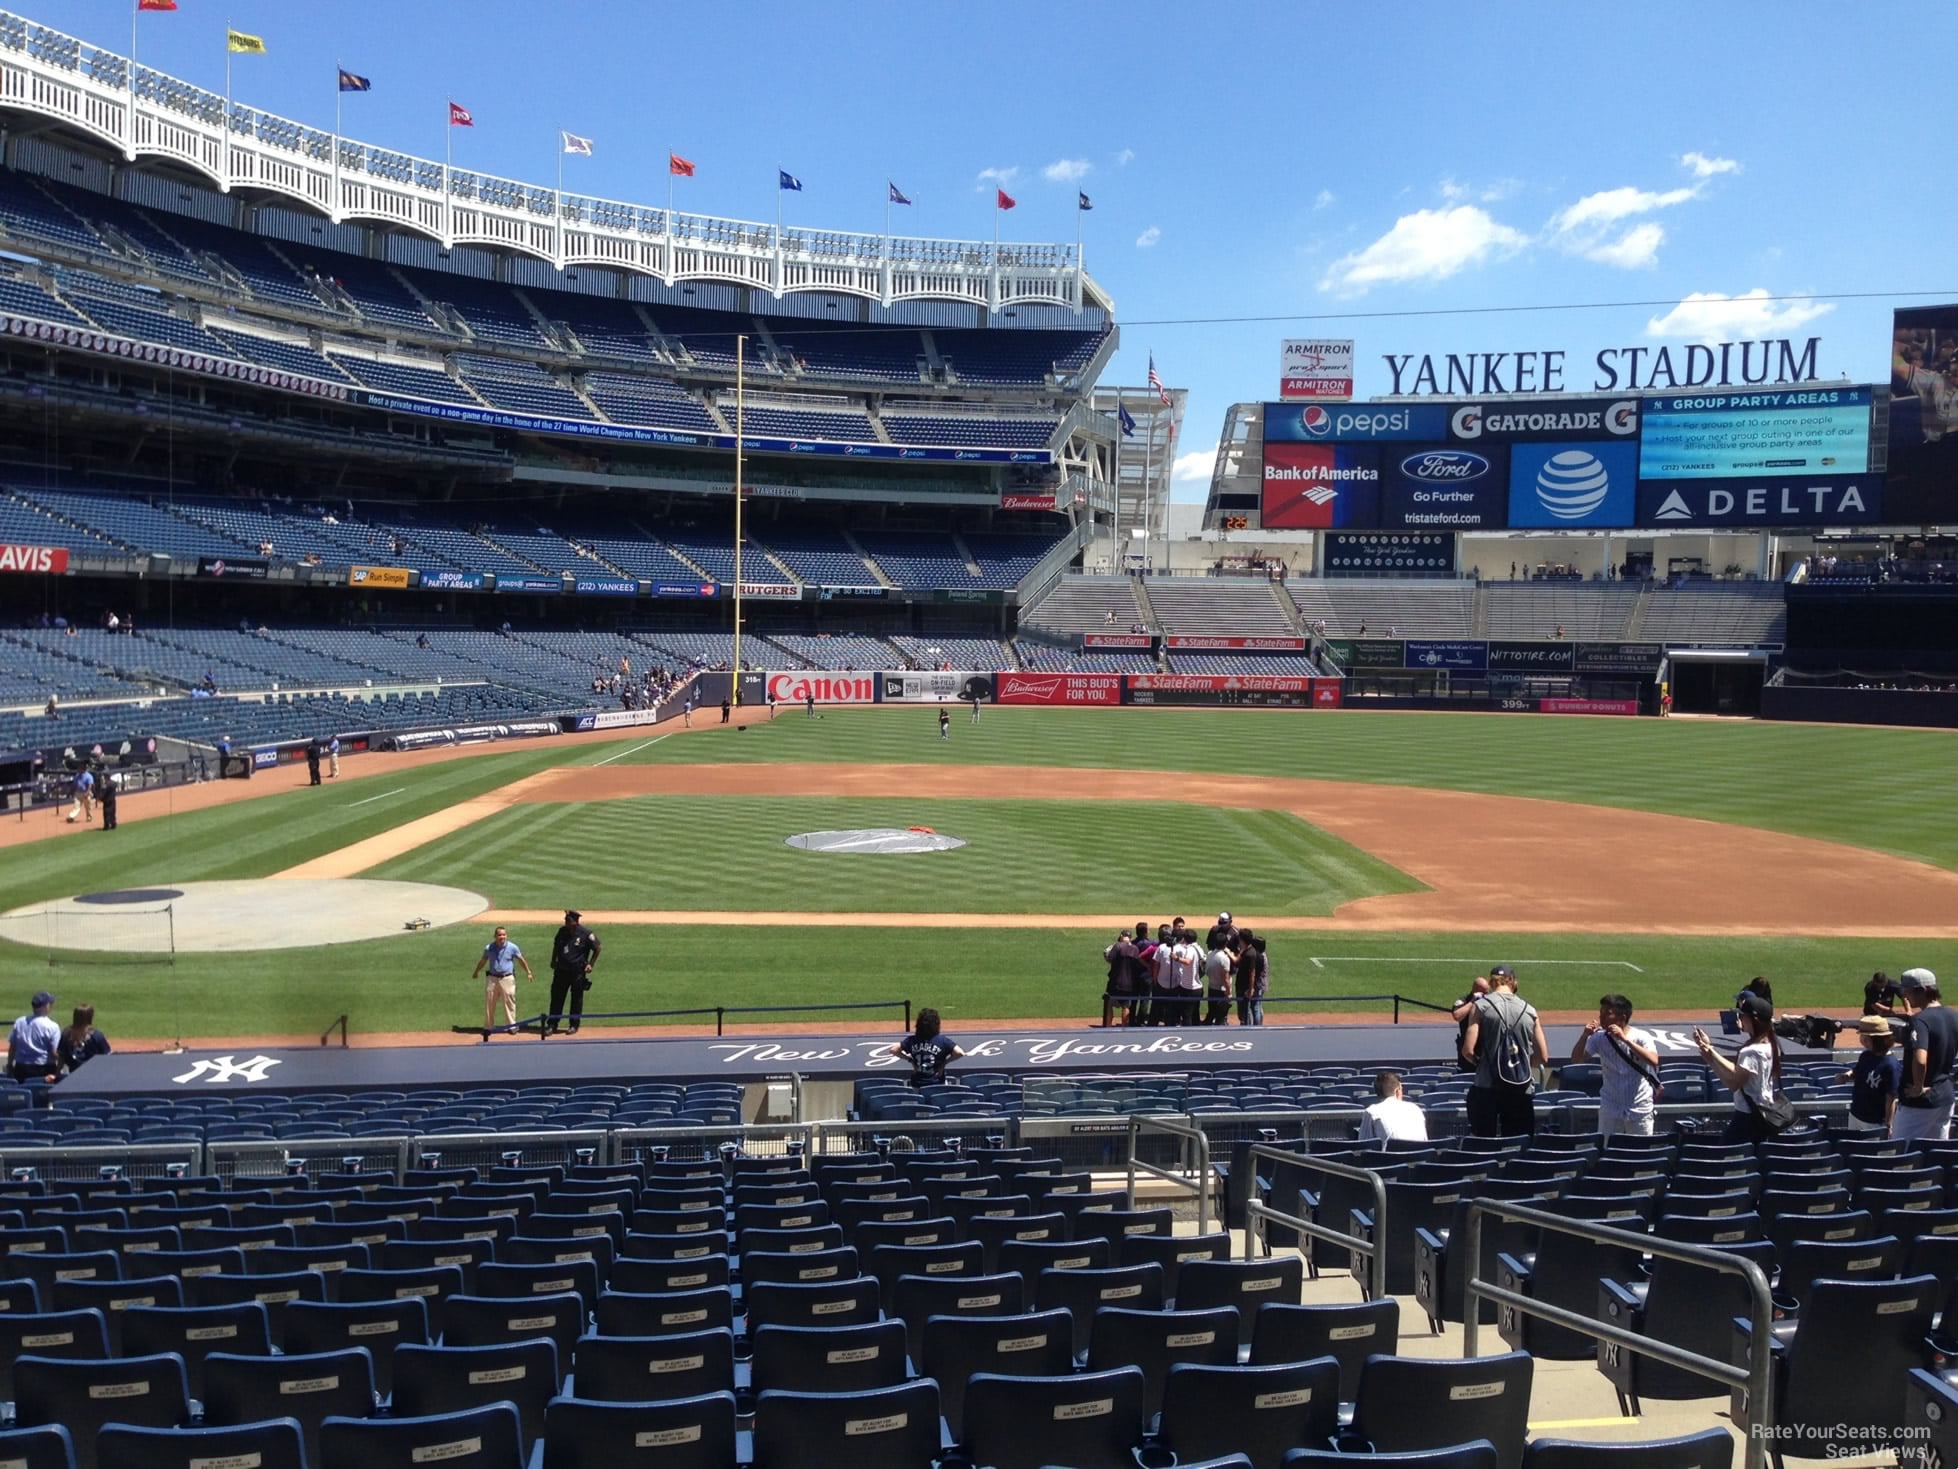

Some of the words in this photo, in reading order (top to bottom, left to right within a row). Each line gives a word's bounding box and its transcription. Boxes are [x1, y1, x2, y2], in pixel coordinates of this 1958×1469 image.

[1285, 344, 1351, 354] ARMITRON
[1382, 350, 1566, 396] YANKEE
[1594, 337, 1822, 392] STADIUM
[1287, 380, 1346, 389] ARMITRON
[1673, 398, 1726, 409] GROUP
[1730, 395, 1781, 407] PARTY
[1785, 391, 1839, 405] AREAS
[368, 394, 384, 406] Host
[390, 399, 412, 412] private
[413, 404, 431, 414] event
[447, 409, 481, 421] non-game
[481, 412, 494, 423] day
[495, 414, 501, 422] in
[502, 415, 513, 425] the
[514, 416, 532, 427] home
[535, 419, 541, 428] of
[541, 420, 553, 430] the
[553, 421, 562, 430] 27
[563, 422, 578, 433] time
[579, 424, 599, 435] World
[600, 427, 634, 439] Champion
[634, 429, 651, 440] New
[652, 431, 668, 441] York
[669, 433, 697, 444] Yankees
[1336, 409, 1409, 435] pepsi
[1485, 411, 1601, 431] GATORADE
[1701, 420, 1733, 430] groups
[1736, 419, 1745, 428] of
[1748, 419, 1758, 427] 10
[1800, 415, 1833, 425] people
[1662, 434, 1682, 442] Host
[1686, 434, 1706, 443] your
[1708, 432, 1728, 440] next
[1731, 432, 1759, 441] group
[1761, 430, 1791, 440] outing
[1827, 428, 1836, 436] of
[1838, 428, 1854, 436] our
[798, 443, 815, 452] pepsi
[1739, 441, 1767, 450] group
[1770, 440, 1794, 449] party
[1797, 438, 1823, 446] areas
[853, 446, 870, 455] pepsi
[908, 449, 926, 458] pepsi
[963, 451, 981, 459] pepsi
[1018, 452, 1037, 461] pepsi
[1416, 454, 1472, 478] Ford
[1265, 467, 1301, 480] Bank
[1302, 467, 1318, 480] of
[1319, 466, 1378, 480] America
[1413, 492, 1429, 502] Go
[1432, 491, 1474, 502] Further
[1708, 485, 1867, 516] DELTA
[1003, 496, 1055, 510] Budweiser
[1404, 513, 1481, 524] tristateford.com
[0, 549, 52, 571] AVIS
[354, 571, 366, 581] SAP
[369, 574, 383, 582] Run
[383, 574, 405, 584] Simple
[438, 573, 463, 582] GROUP
[428, 579, 449, 588] PARTY
[450, 580, 473, 589] AREAS
[577, 582, 596, 591] (212)
[597, 582, 634, 592] YANKEES
[739, 585, 798, 595] RUTGERS
[1490, 650, 1571, 661] NITTOTIRE.COM
[768, 674, 871, 701] Canon
[1008, 682, 1054, 693] Budweiser
[1067, 678, 1087, 689] THIS
[1090, 678, 1118, 689] BUD'S
[1067, 690, 1085, 700] FOR
[1087, 690, 1108, 700] YOU.
[255, 751, 277, 763] GEICO
[708, 1043, 850, 1063] New
[1013, 1036, 1255, 1065] Yankees
